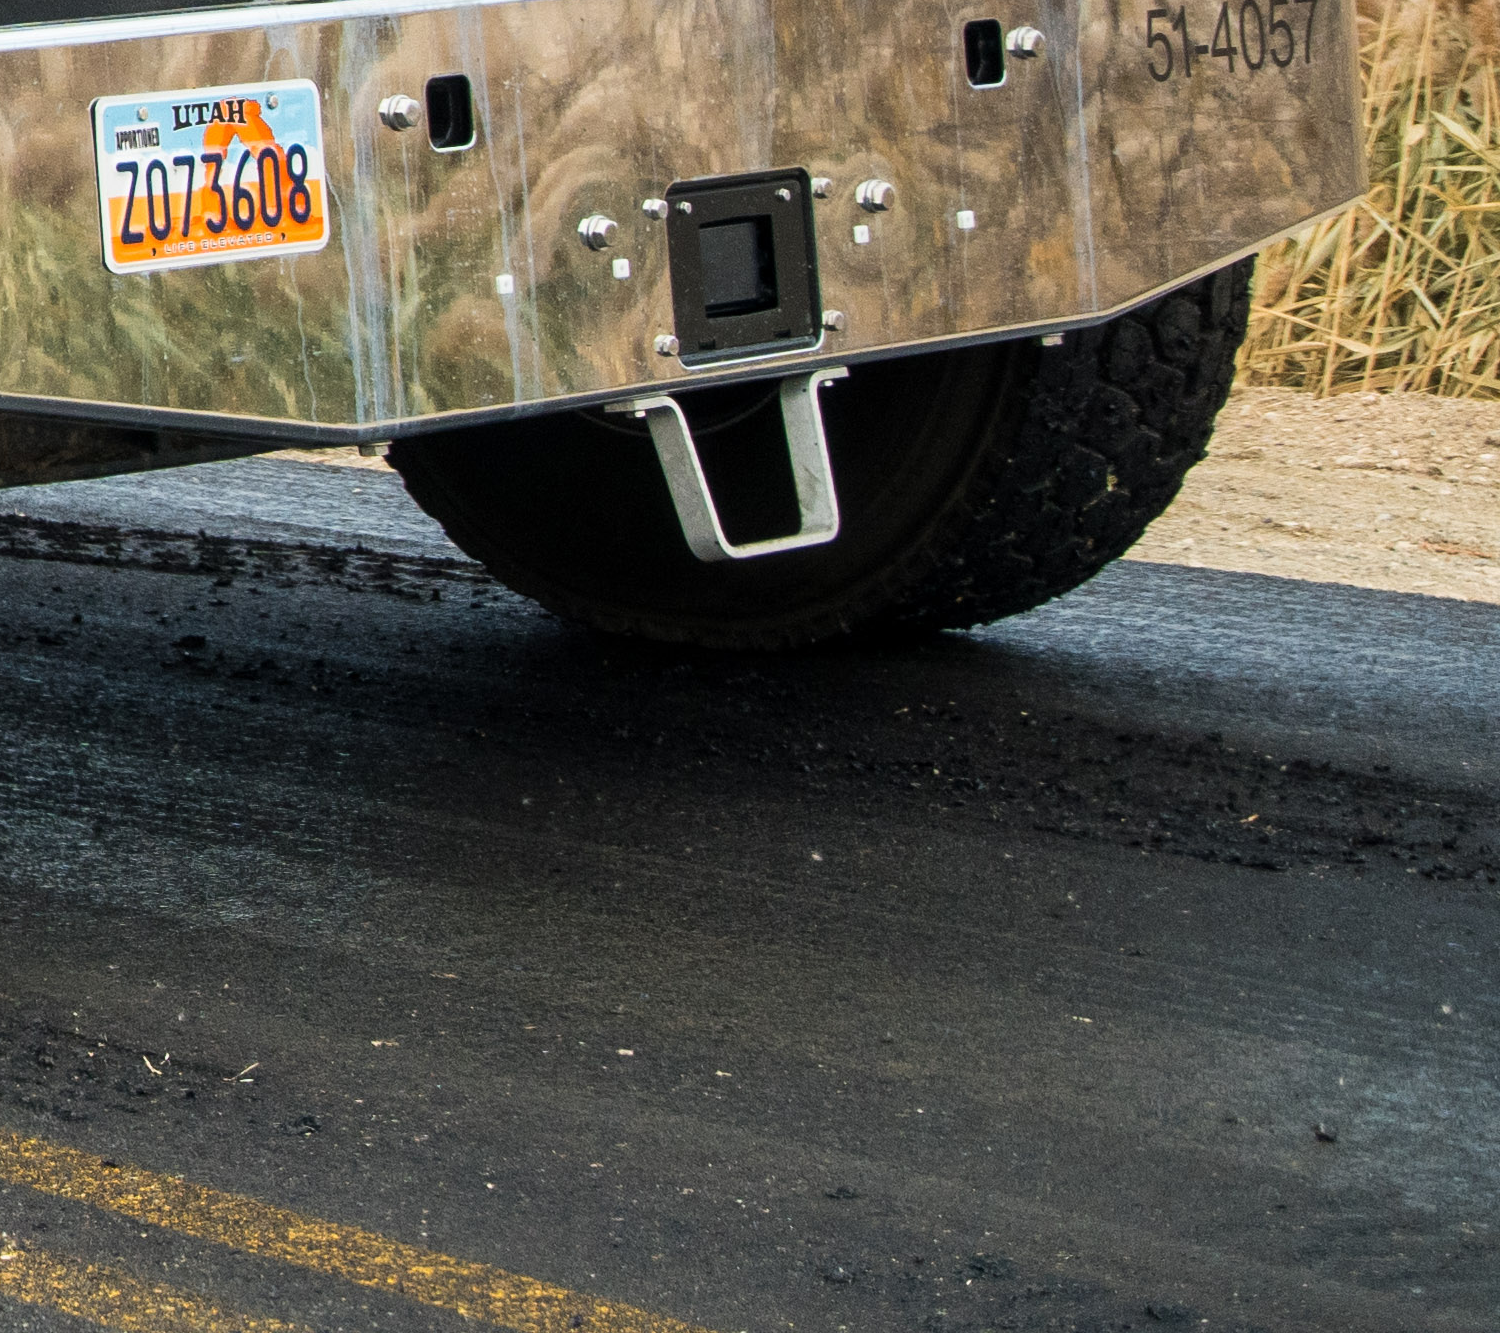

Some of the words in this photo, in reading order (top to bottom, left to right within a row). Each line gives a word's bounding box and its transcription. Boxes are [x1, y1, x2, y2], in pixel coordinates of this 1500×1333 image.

[171, 98, 248, 131] UTAH
[116, 127, 161, 151] APPORTIONED
[115, 143, 312, 245] Z073608
[163, 241, 195, 253] LIFE
[200, 231, 274, 250] ELEVATED
